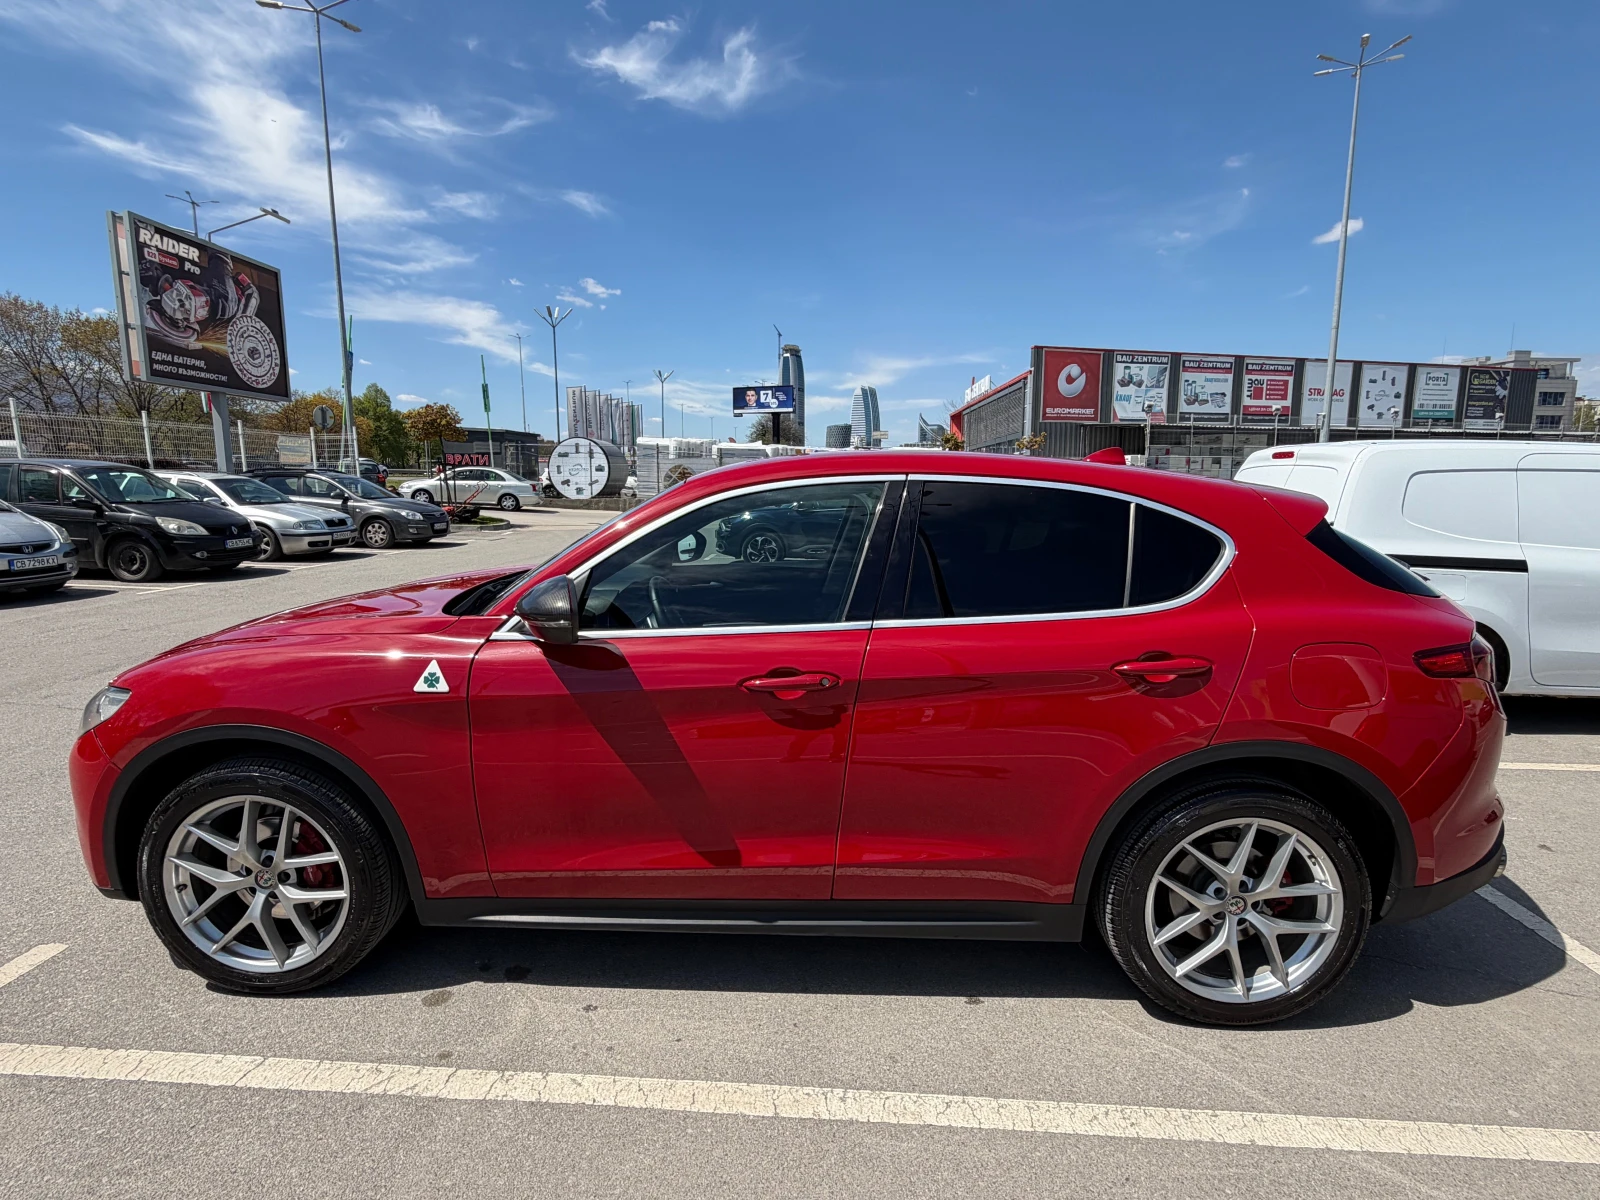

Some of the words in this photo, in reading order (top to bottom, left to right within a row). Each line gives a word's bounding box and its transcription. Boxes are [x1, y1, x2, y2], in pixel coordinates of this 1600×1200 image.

[139, 227, 200, 262] RAIDER
[184, 261, 201, 275] Pro
[151, 351, 172, 362] ЕДНА
[1134, 355, 1168, 363] ZENTRUM
[153, 363, 177, 374] МНОГО
[178, 368, 228, 382] ВЪЗМОЖНОСТИ!
[763, 393, 769, 401] 7
[1308, 387, 1345, 397] STRAAG
[1045, 407, 1095, 415] EUROMARKET
[446, 453, 489, 466] ВРАТИ
[15, 560, 26, 568] CB
[27, 558, 45, 567] 7298
